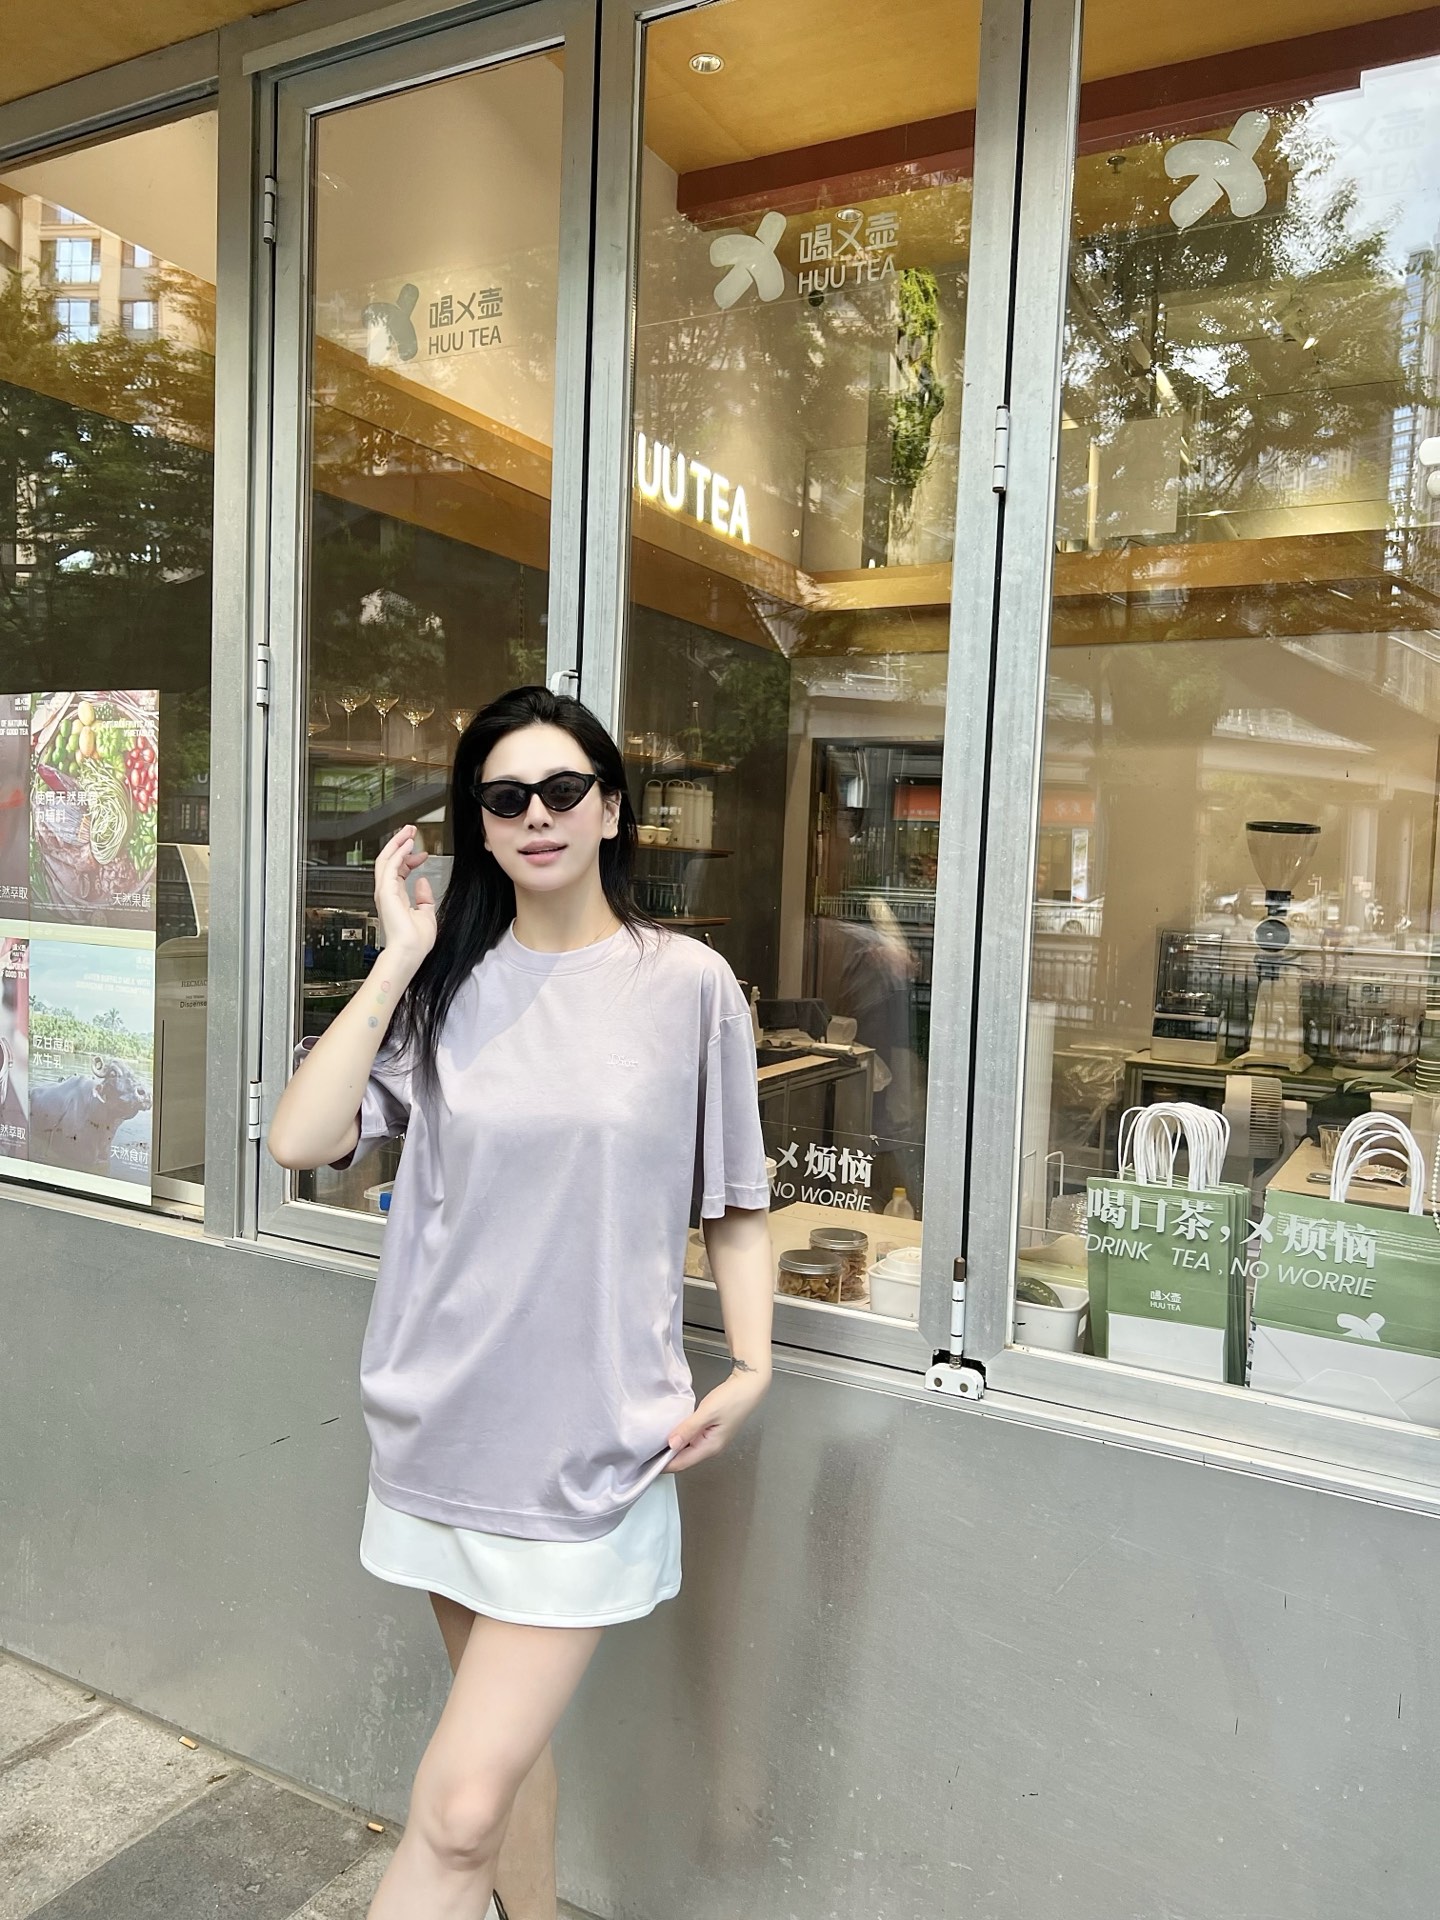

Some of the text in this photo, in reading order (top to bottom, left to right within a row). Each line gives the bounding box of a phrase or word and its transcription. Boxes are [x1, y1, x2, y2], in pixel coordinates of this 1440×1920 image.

[798, 253, 899, 294] HUU TEA
[428, 325, 502, 355] HUU TEA
[632, 431, 751, 545] UU TEA
[19, 728, 29, 736] TEA
[0, 885, 29, 900] 然萃取
[112, 892, 151, 908] 天然果蔬
[32, 1052, 64, 1069] 水牛乳
[110, 1145, 149, 1165] 天然食材
[801, 1185, 873, 1213] WORRIE
[1084, 1233, 1153, 1262] DRINK
[1230, 1257, 1270, 1280] NO
[1278, 1264, 1378, 1299] WORRIE
[1150, 1300, 1182, 1312] HUU TEA
